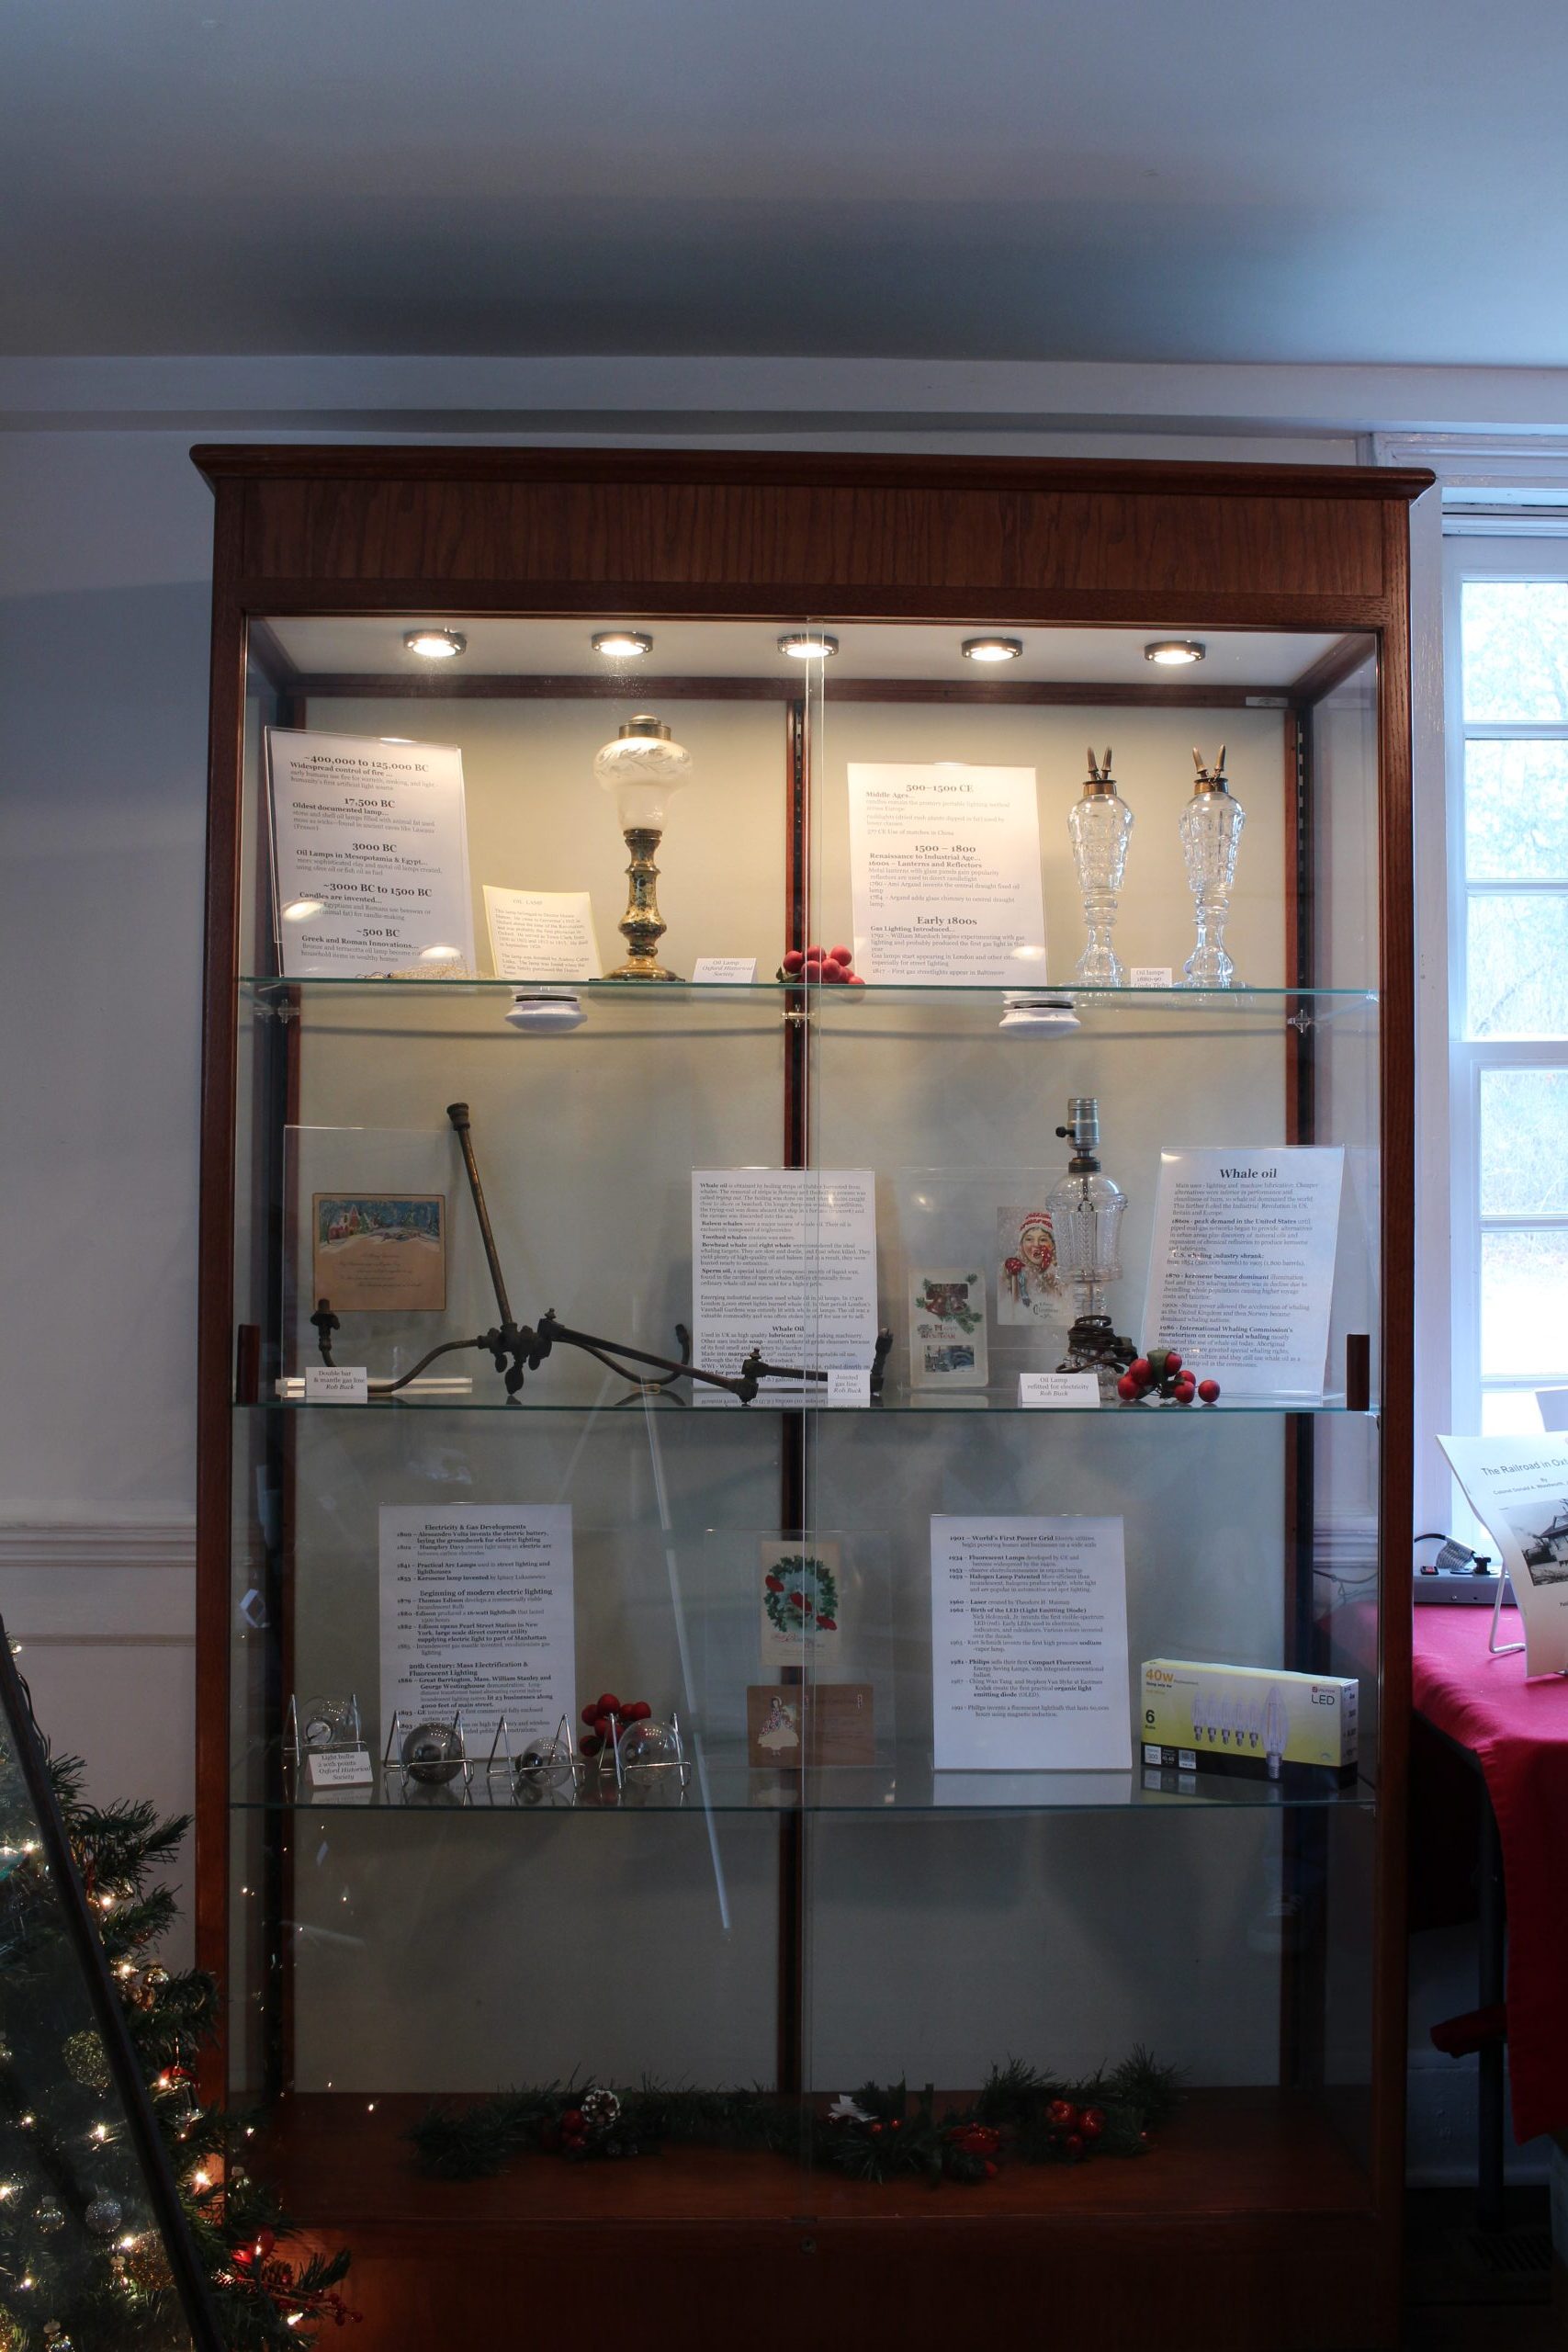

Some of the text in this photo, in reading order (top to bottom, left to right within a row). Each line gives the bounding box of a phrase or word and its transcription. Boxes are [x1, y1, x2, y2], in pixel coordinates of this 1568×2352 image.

[290, 761, 333, 771] Widespread
[372, 768, 384, 776] fire
[304, 756, 355, 765] ~400,000
[372, 761, 412, 770] 125,000
[344, 798, 396, 808] 17,500 BC
[292, 801, 389, 817] Oldest documented lamp...
[382, 844, 397, 853] BC
[310, 850, 333, 859] Lamps
[344, 853, 392, 863] Mesopotamia
[401, 857, 428, 866] Egypt...
[360, 884, 376, 892] BC
[378, 886, 388, 894] to
[390, 888, 415, 896] 1500
[417, 888, 433, 897] BC
[299, 891, 328, 899] Candles
[344, 895, 382, 903] invented...
[917, 917, 944, 926] Early
[385, 930, 400, 938] BC
[342, 937, 367, 945] Roman
[368, 939, 419, 948] Innovations...
[1220, 1169, 1277, 1178] Whale oil
[1223, 1325, 1248, 1333] Whaling
[1481, 1467, 1500, 1476] The
[1500, 1463, 1540, 1474] Railroad
[420, 1589, 456, 1597] Beginning
[1312, 1694, 1335, 1705] LED
[1145, 1710, 1155, 1724] 6
